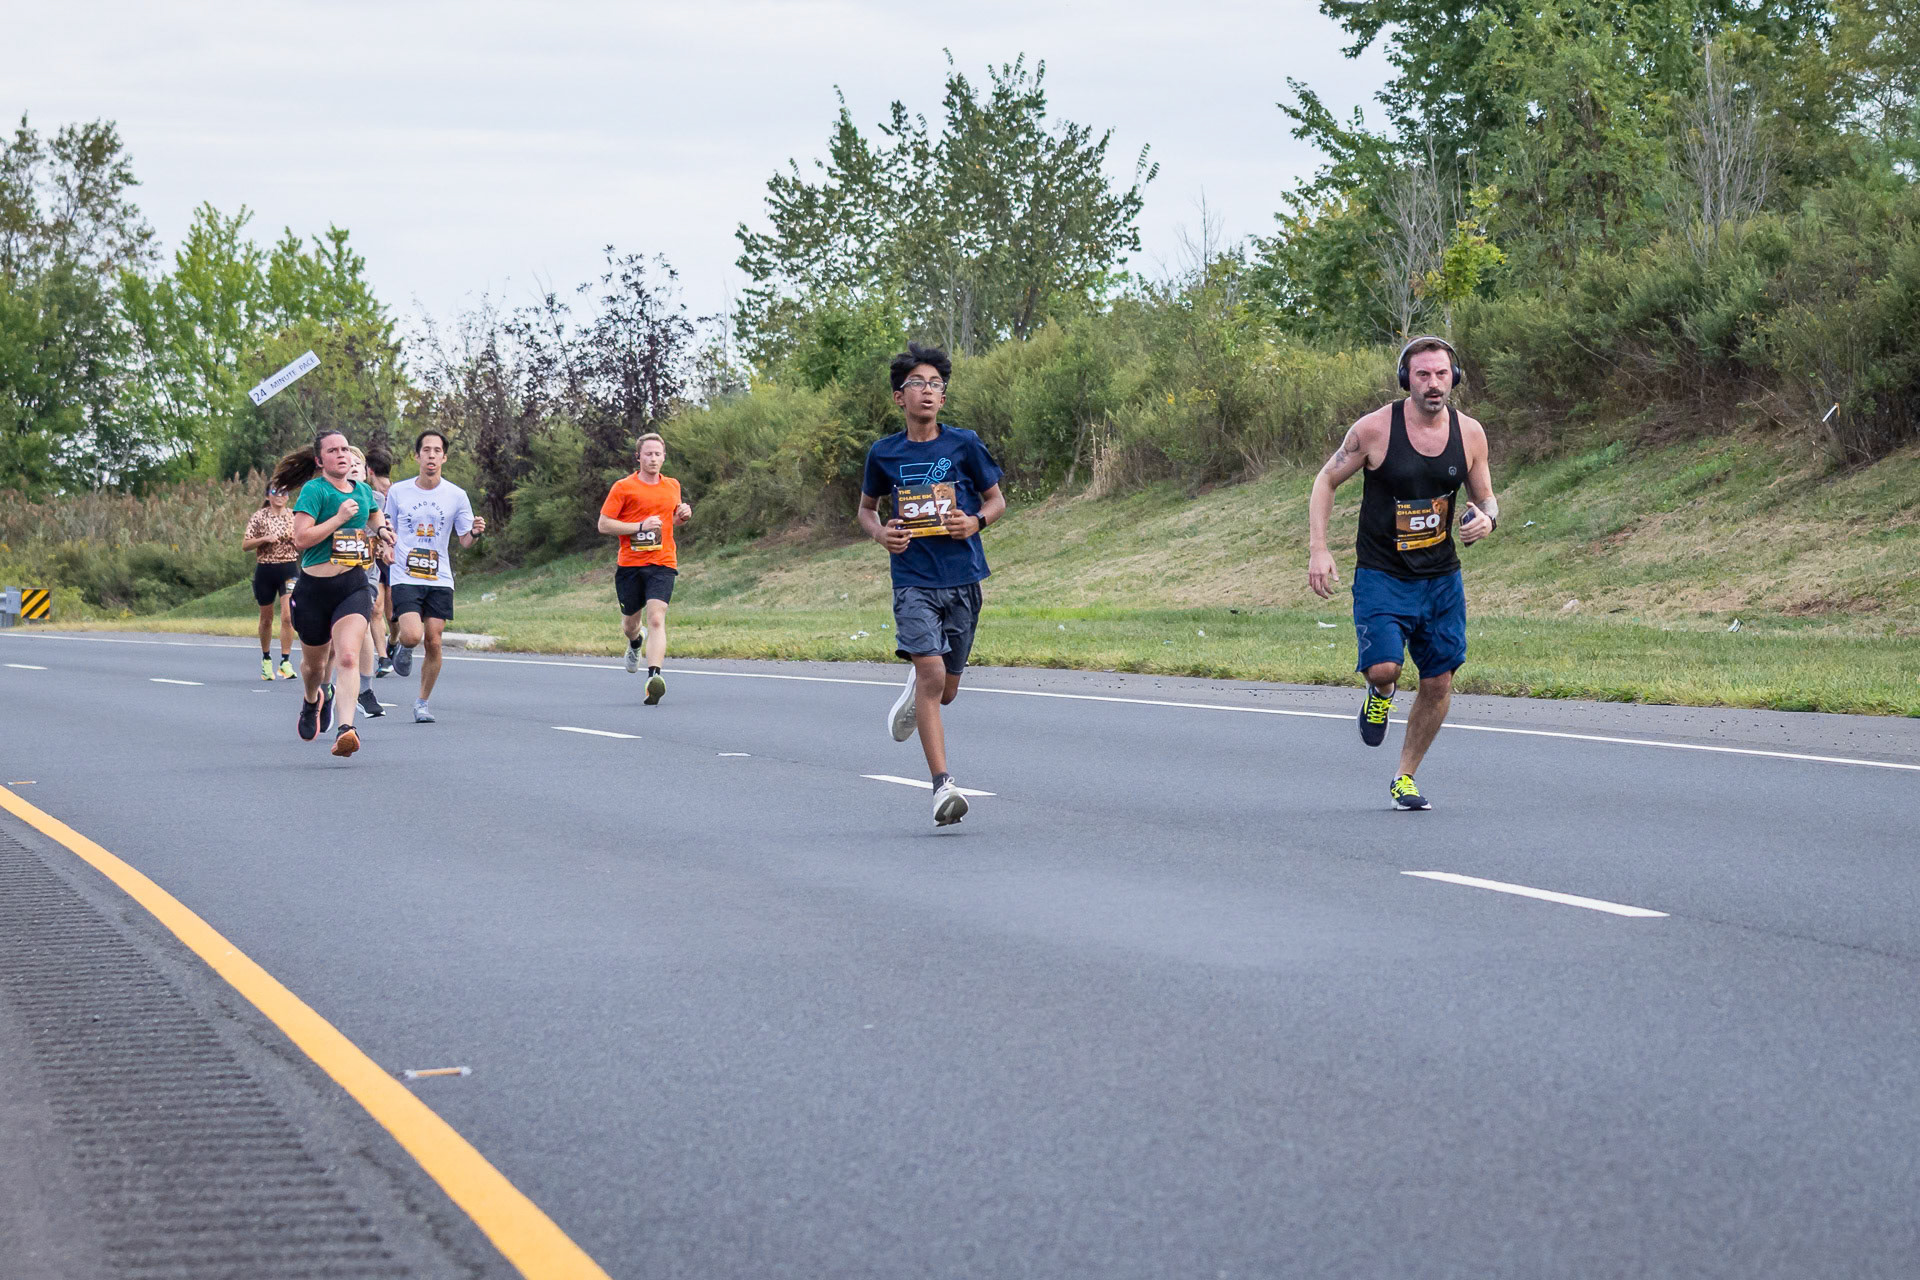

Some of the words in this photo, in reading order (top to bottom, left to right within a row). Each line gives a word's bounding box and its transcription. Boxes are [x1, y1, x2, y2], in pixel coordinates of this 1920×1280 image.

[253, 388, 267, 402] 24
[270, 369, 297, 389] MINUTE
[298, 357, 315, 372] PACE
[899, 494, 921, 502] CHASE
[903, 499, 952, 518] 347
[1410, 514, 1440, 530] 50
[636, 531, 656, 541] 90
[335, 540, 366, 552] 322
[408, 556, 438, 569] 263
